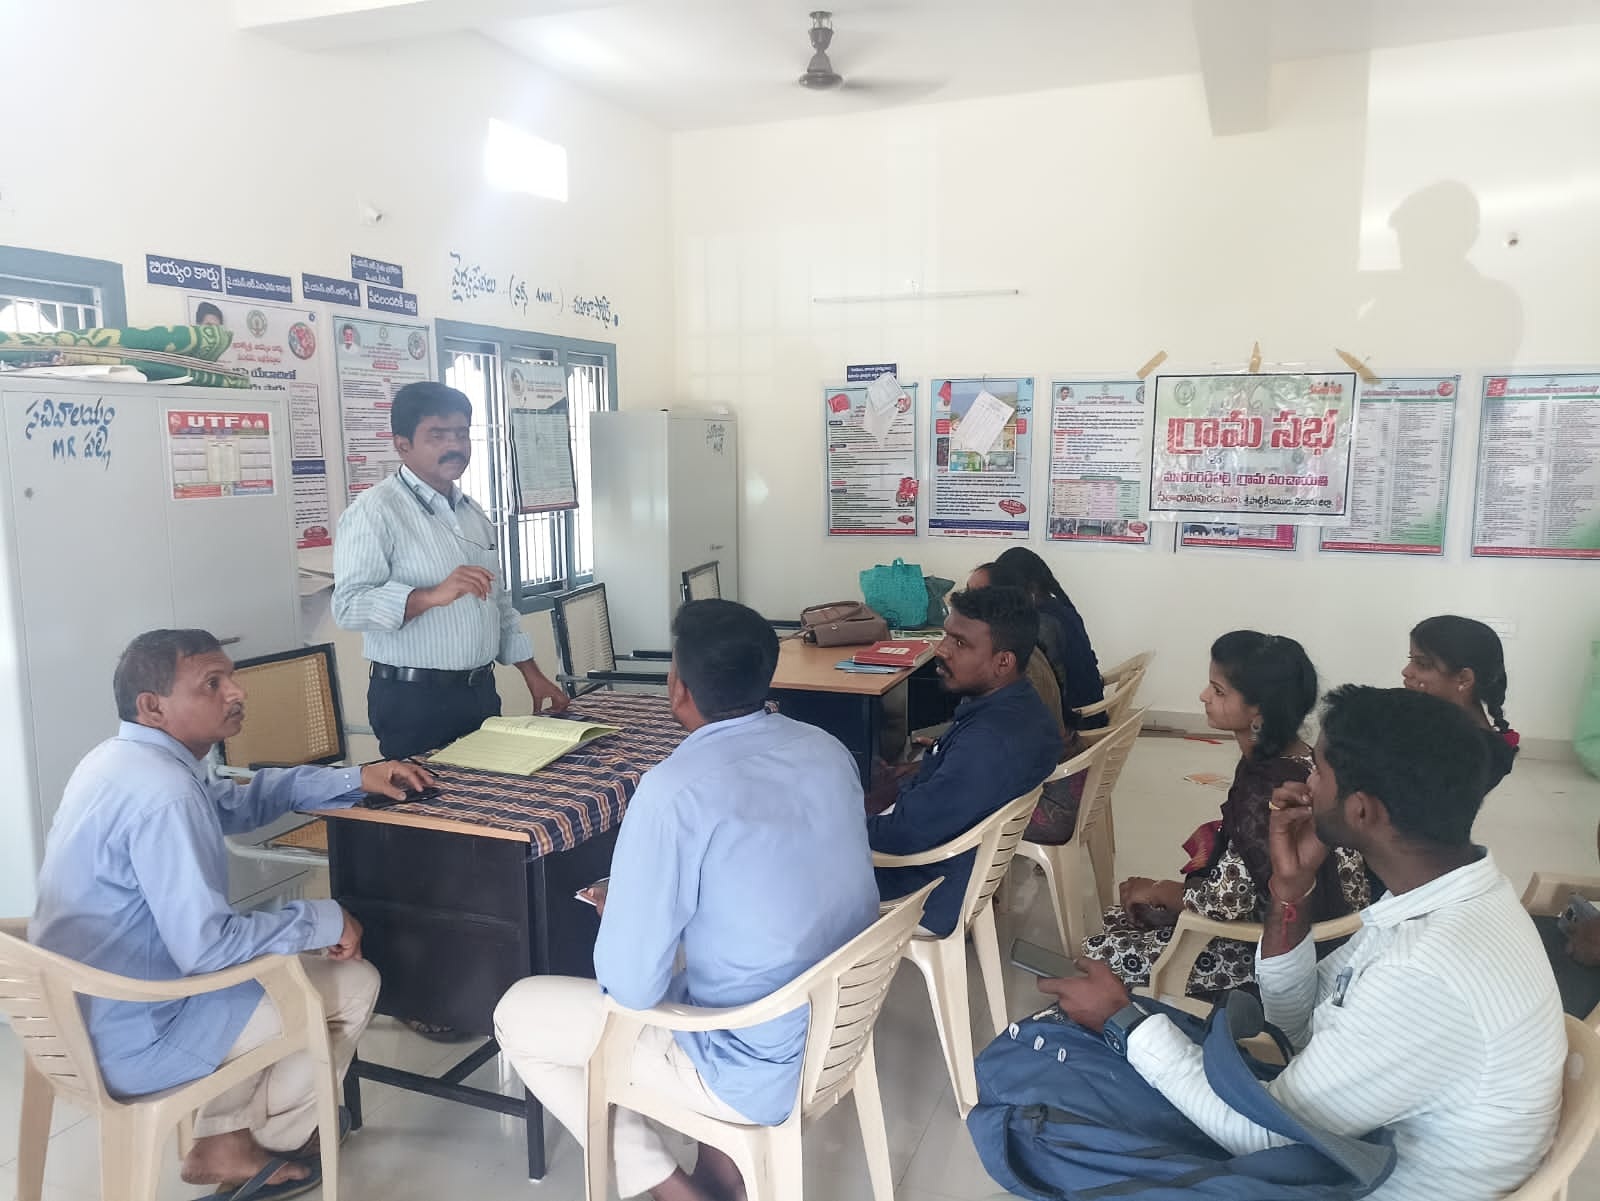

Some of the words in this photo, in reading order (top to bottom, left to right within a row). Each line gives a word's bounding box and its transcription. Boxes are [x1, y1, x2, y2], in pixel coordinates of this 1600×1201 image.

[149, 260, 192, 283] బియ్యం
[193, 266, 220, 289] కార్డు
[25, 397, 116, 440] సచివాలయం
[187, 415, 240, 428] UTF
[1166, 409, 1263, 455] గ్రామ
[1271, 409, 1339, 456] సభ
[1236, 471, 1265, 486] గ్రామ
